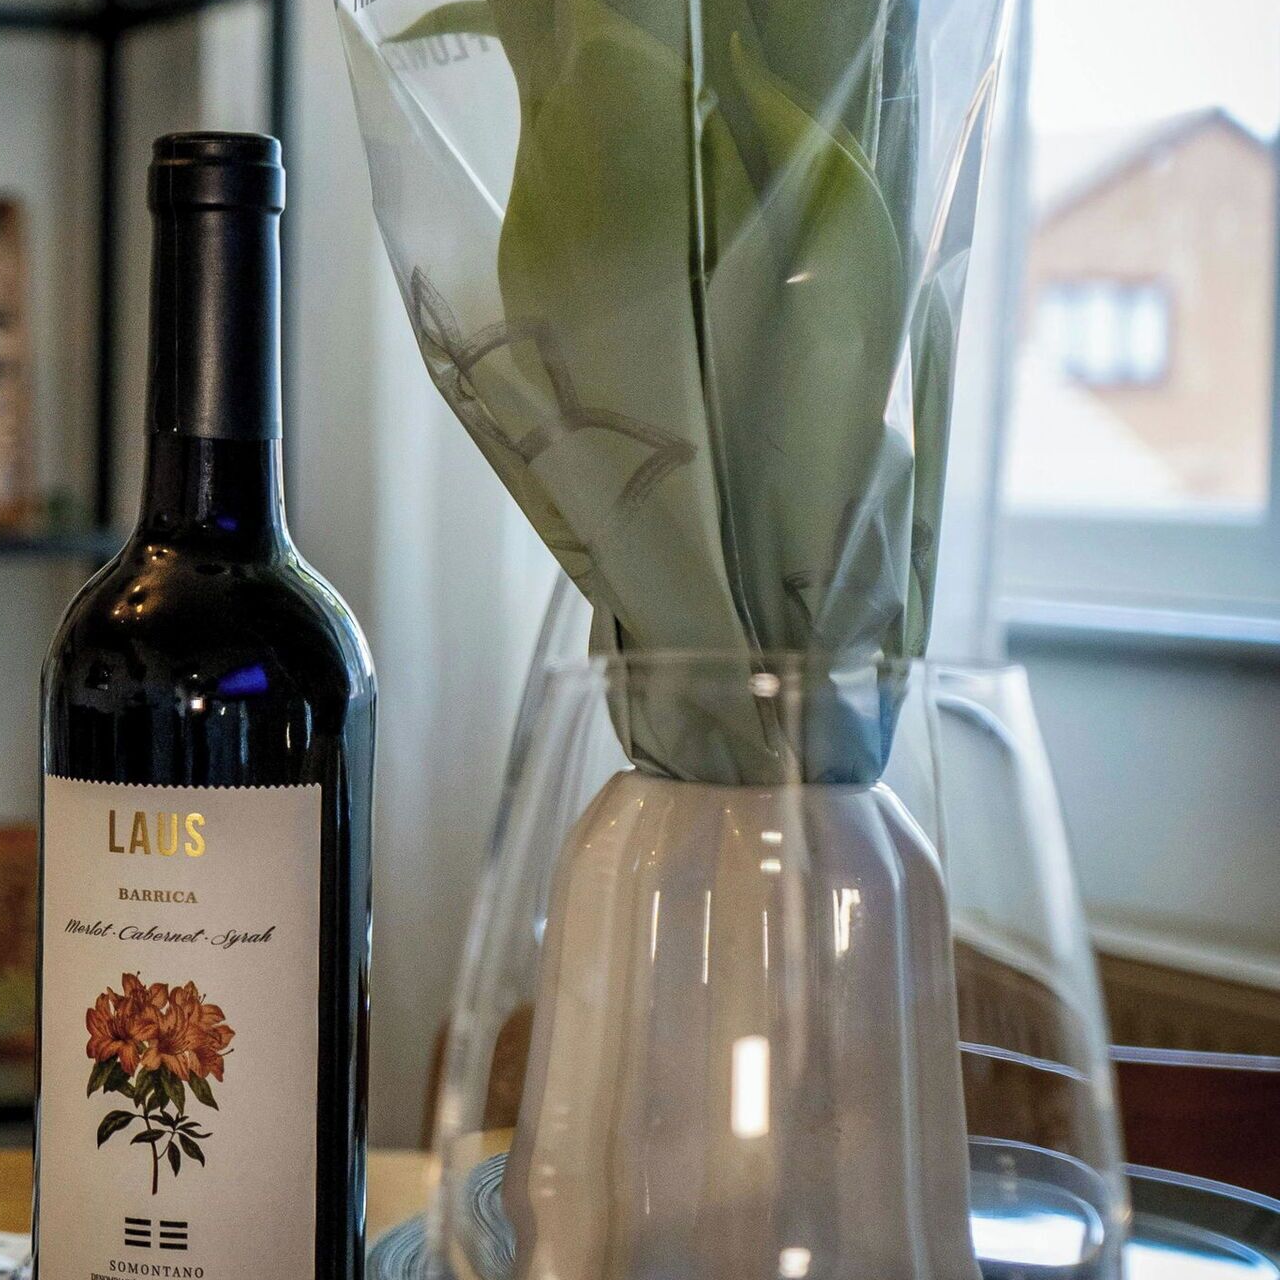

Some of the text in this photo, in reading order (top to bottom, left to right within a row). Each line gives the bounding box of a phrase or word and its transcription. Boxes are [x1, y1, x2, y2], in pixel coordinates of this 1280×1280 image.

[108, 809, 207, 858] LAUS
[118, 887, 199, 904] BARRICA
[64, 918, 276, 950] Merlot Cabernet Syrah
[109, 1259, 205, 1279] SOMONTANO
